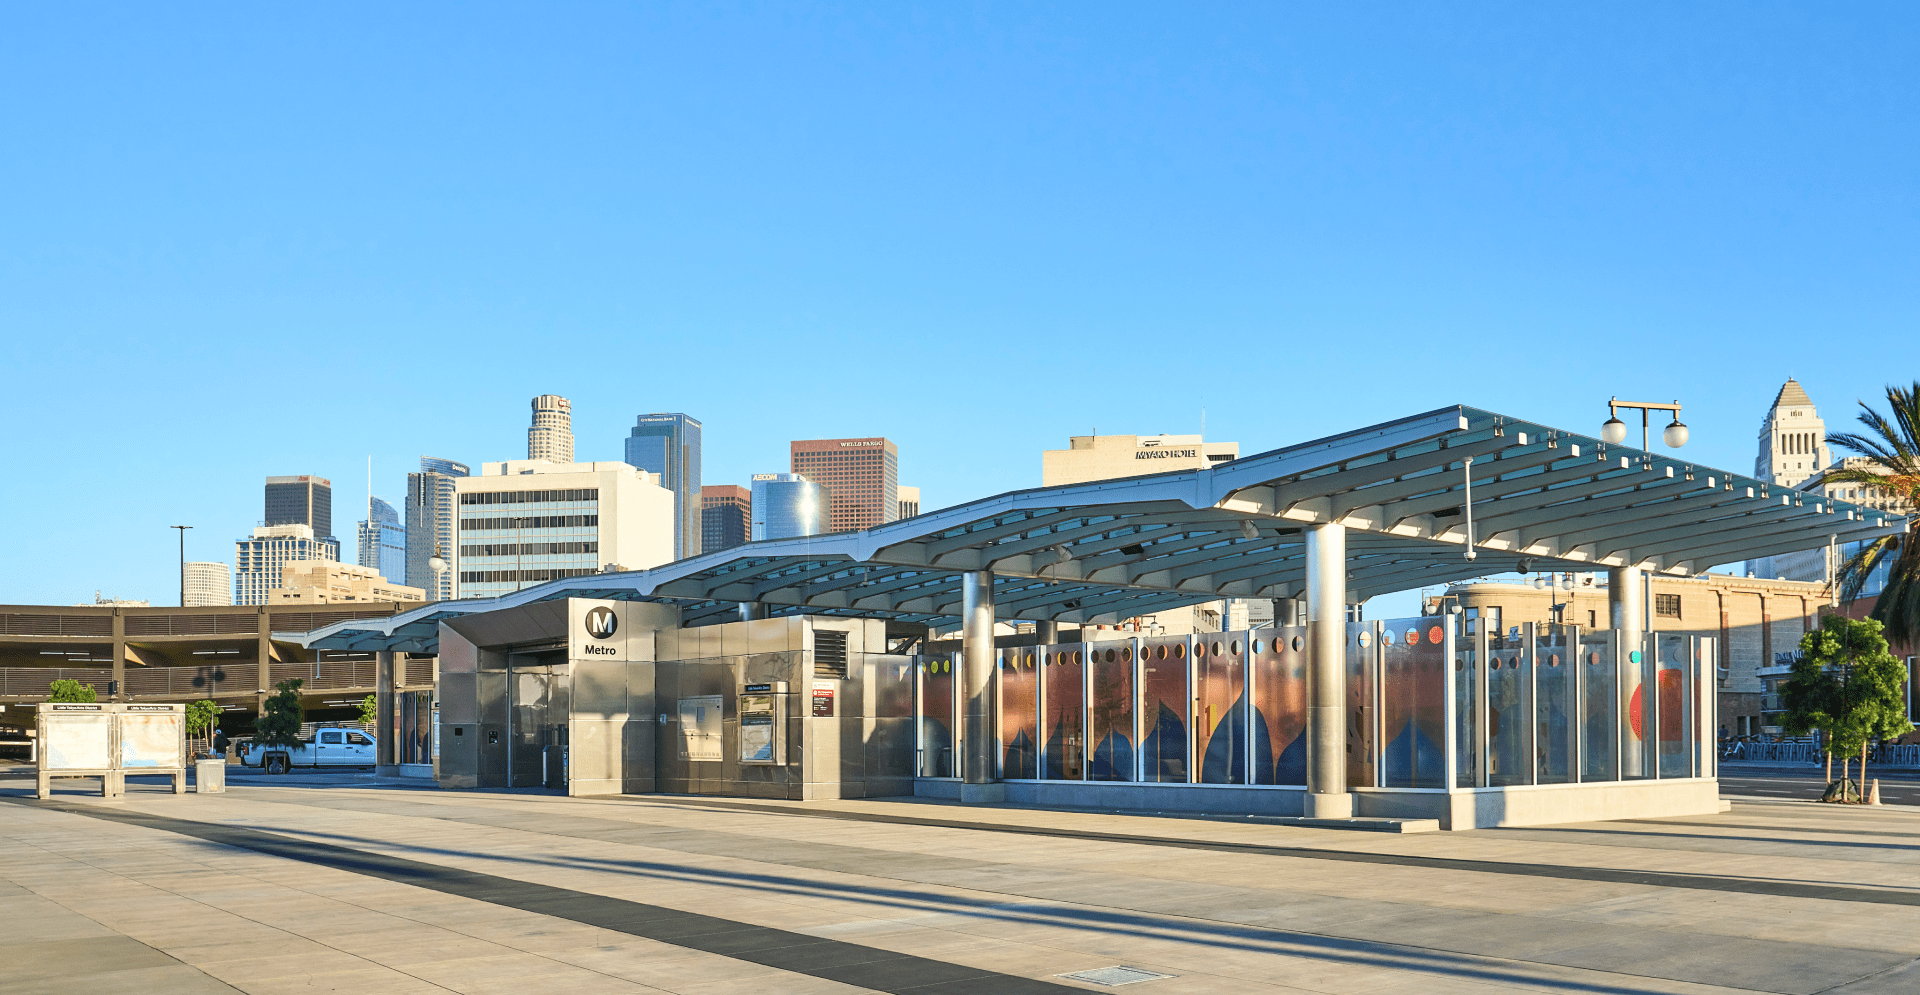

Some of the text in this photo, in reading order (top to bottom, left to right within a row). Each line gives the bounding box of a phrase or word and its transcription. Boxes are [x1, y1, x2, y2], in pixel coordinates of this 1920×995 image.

[1170, 449, 1197, 458] HOTEL
[592, 611, 613, 633] M
[585, 644, 616, 656] Metro
